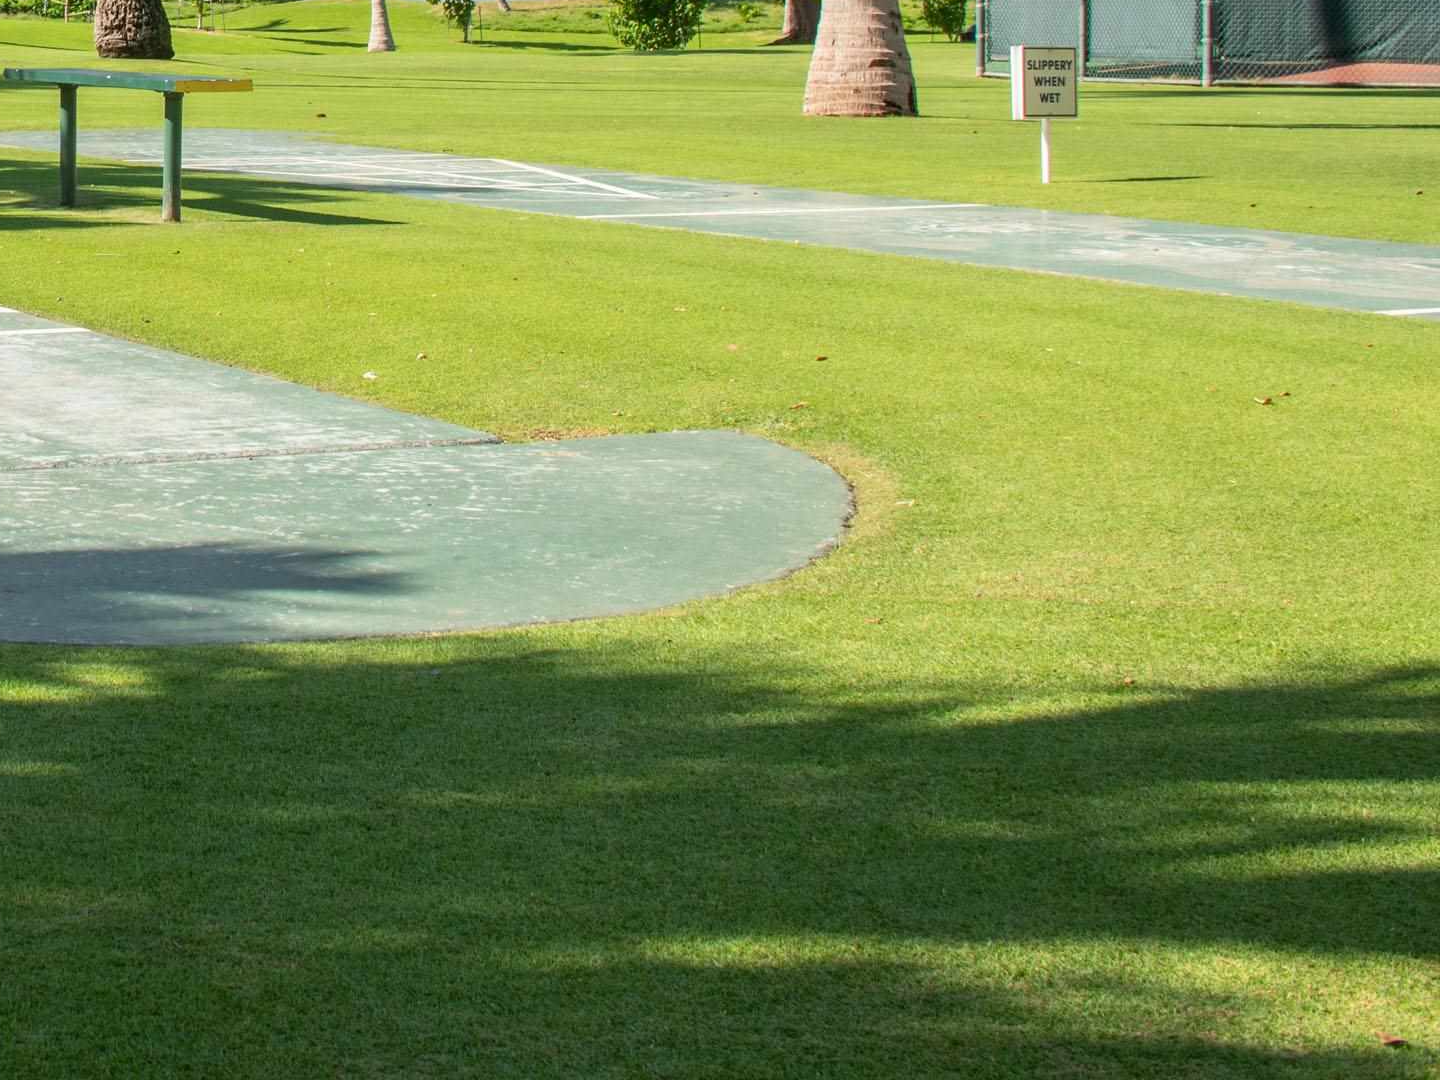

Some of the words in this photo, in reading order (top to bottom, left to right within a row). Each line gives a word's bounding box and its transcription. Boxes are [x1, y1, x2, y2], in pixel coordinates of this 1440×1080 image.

[1027, 60, 1072, 70] SLIPPERY
[1034, 76, 1065, 87] WHEN
[1040, 93, 1061, 103] WET
